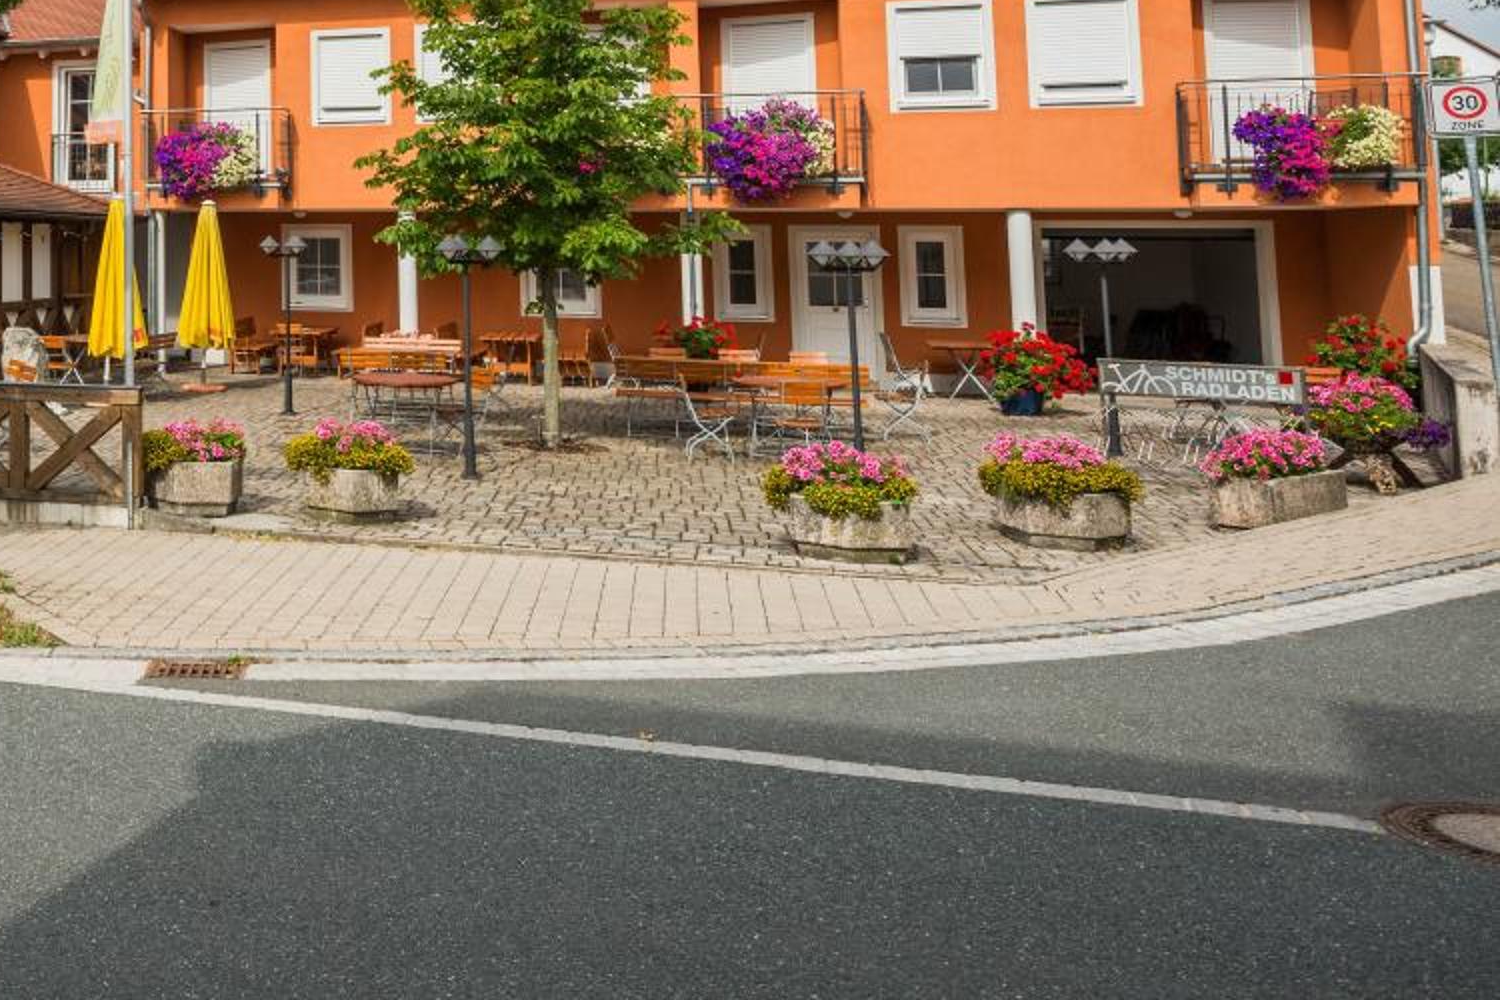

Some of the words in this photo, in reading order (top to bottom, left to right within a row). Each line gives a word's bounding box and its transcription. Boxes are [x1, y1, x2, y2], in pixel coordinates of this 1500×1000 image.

[1451, 94, 1479, 111] 30
[1451, 120, 1484, 130] ZONE
[1165, 365, 1277, 385] SCHMIDT's
[1180, 381, 1295, 401] RADLADEN
